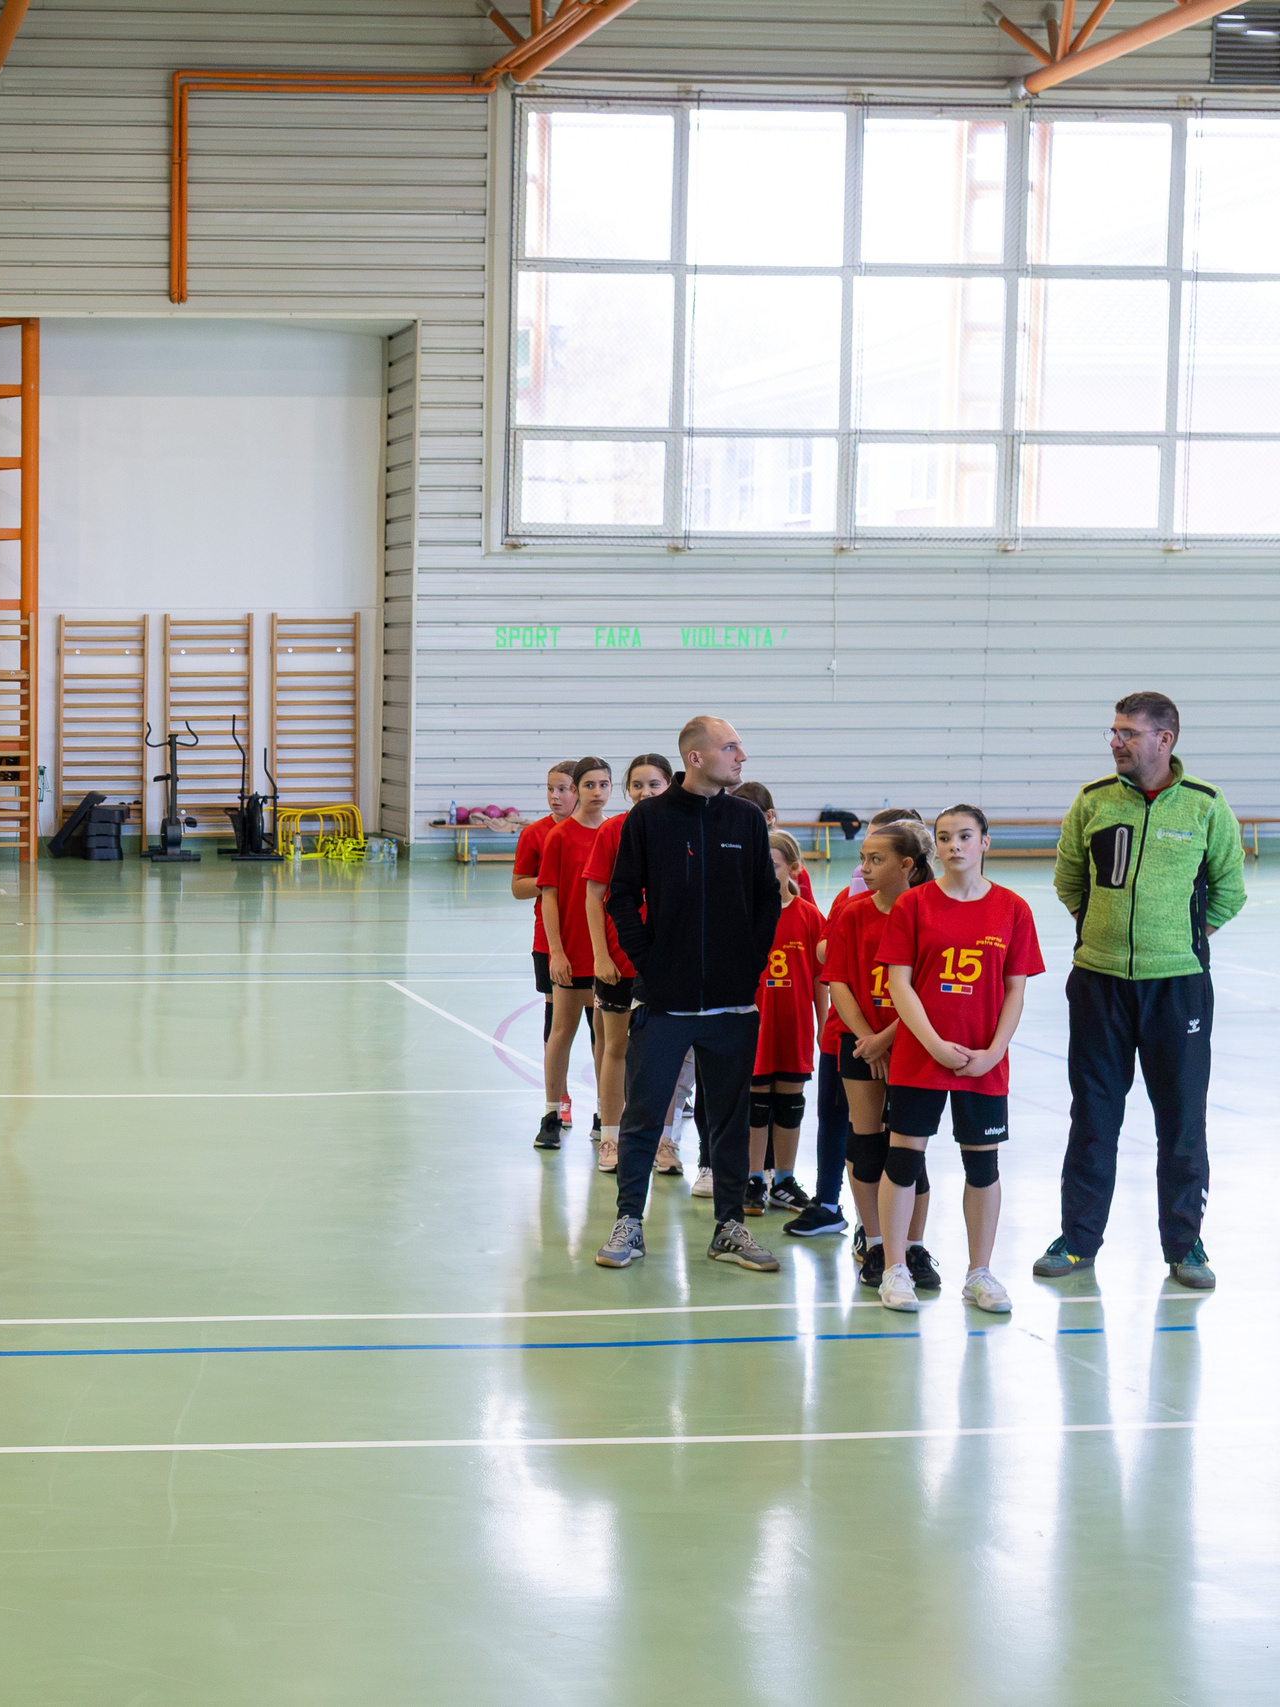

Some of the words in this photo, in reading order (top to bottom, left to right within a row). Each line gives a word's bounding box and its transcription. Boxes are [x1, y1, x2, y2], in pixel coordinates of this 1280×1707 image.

[495, 626, 560, 648] SPORT
[595, 626, 642, 648] FARA
[769, 949, 789, 978] 8
[938, 946, 984, 982] 15
